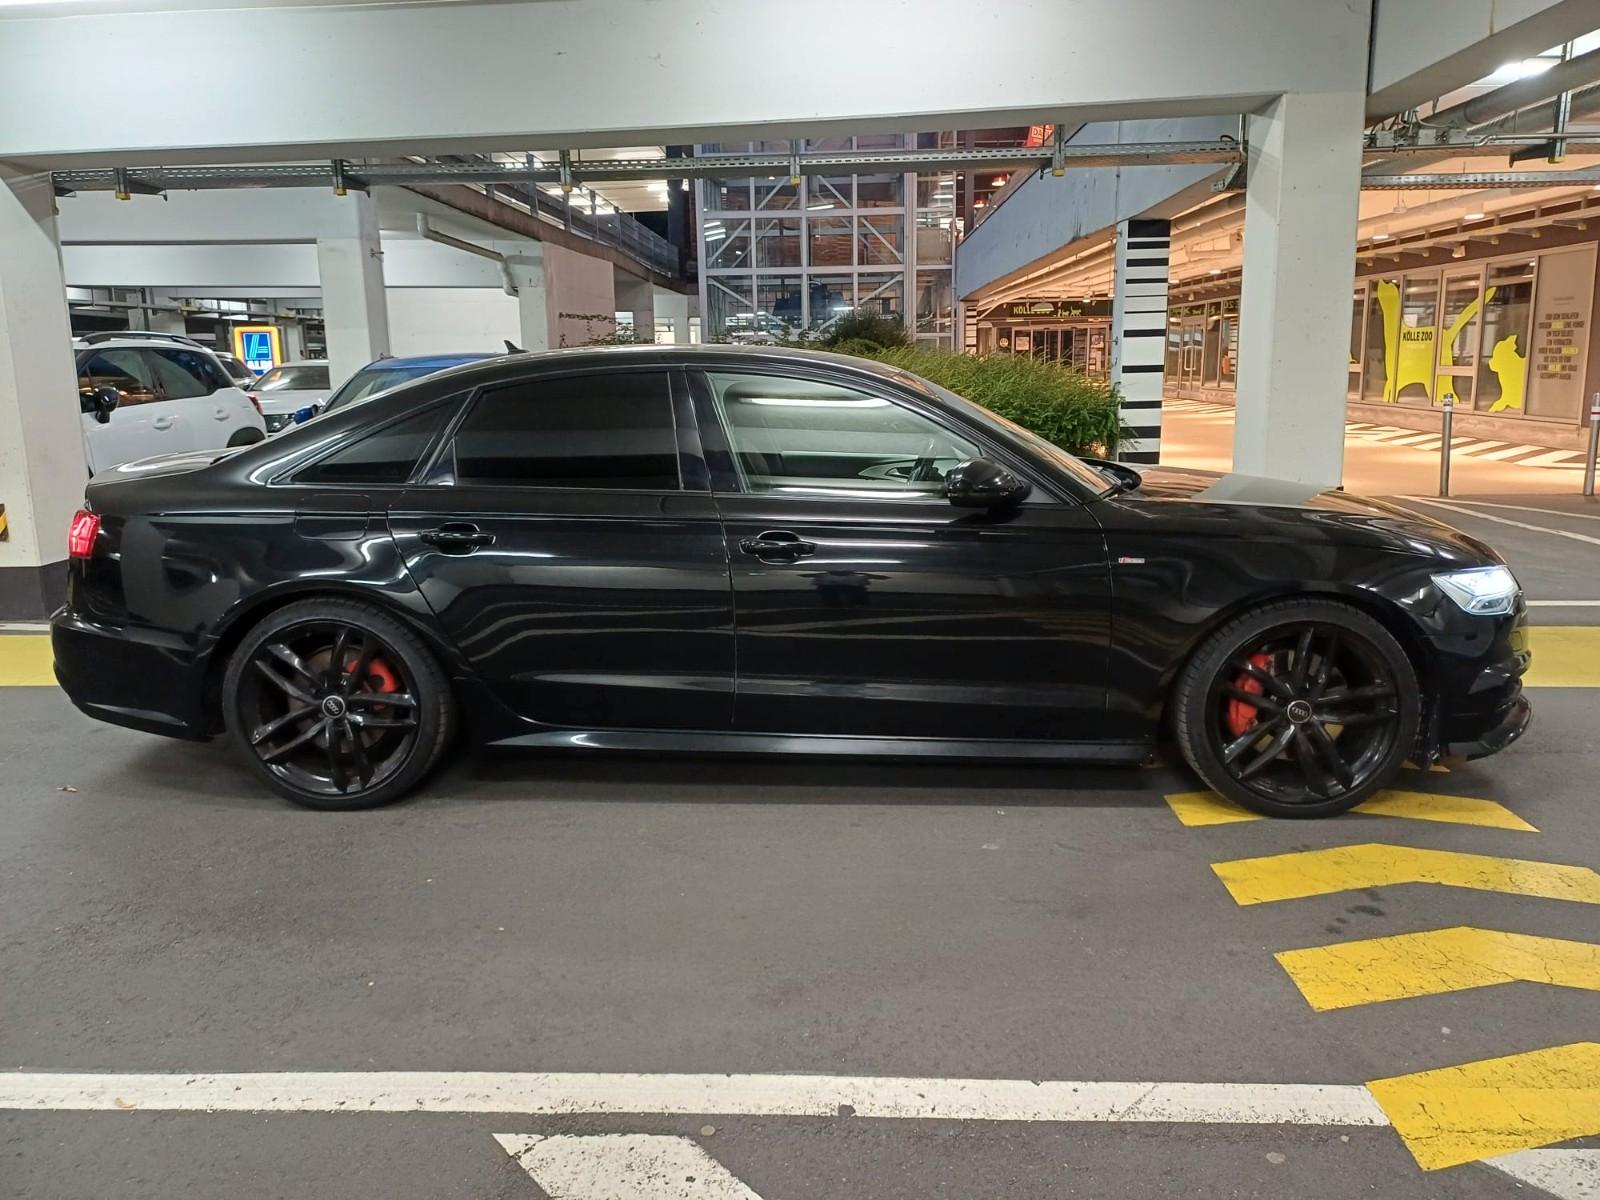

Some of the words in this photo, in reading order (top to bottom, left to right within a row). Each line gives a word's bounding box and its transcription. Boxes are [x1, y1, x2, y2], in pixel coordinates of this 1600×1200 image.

[1403, 330, 1420, 342] KÖLLE
[1421, 331, 1433, 342] ZOO
[247, 360, 273, 370] ALDI
